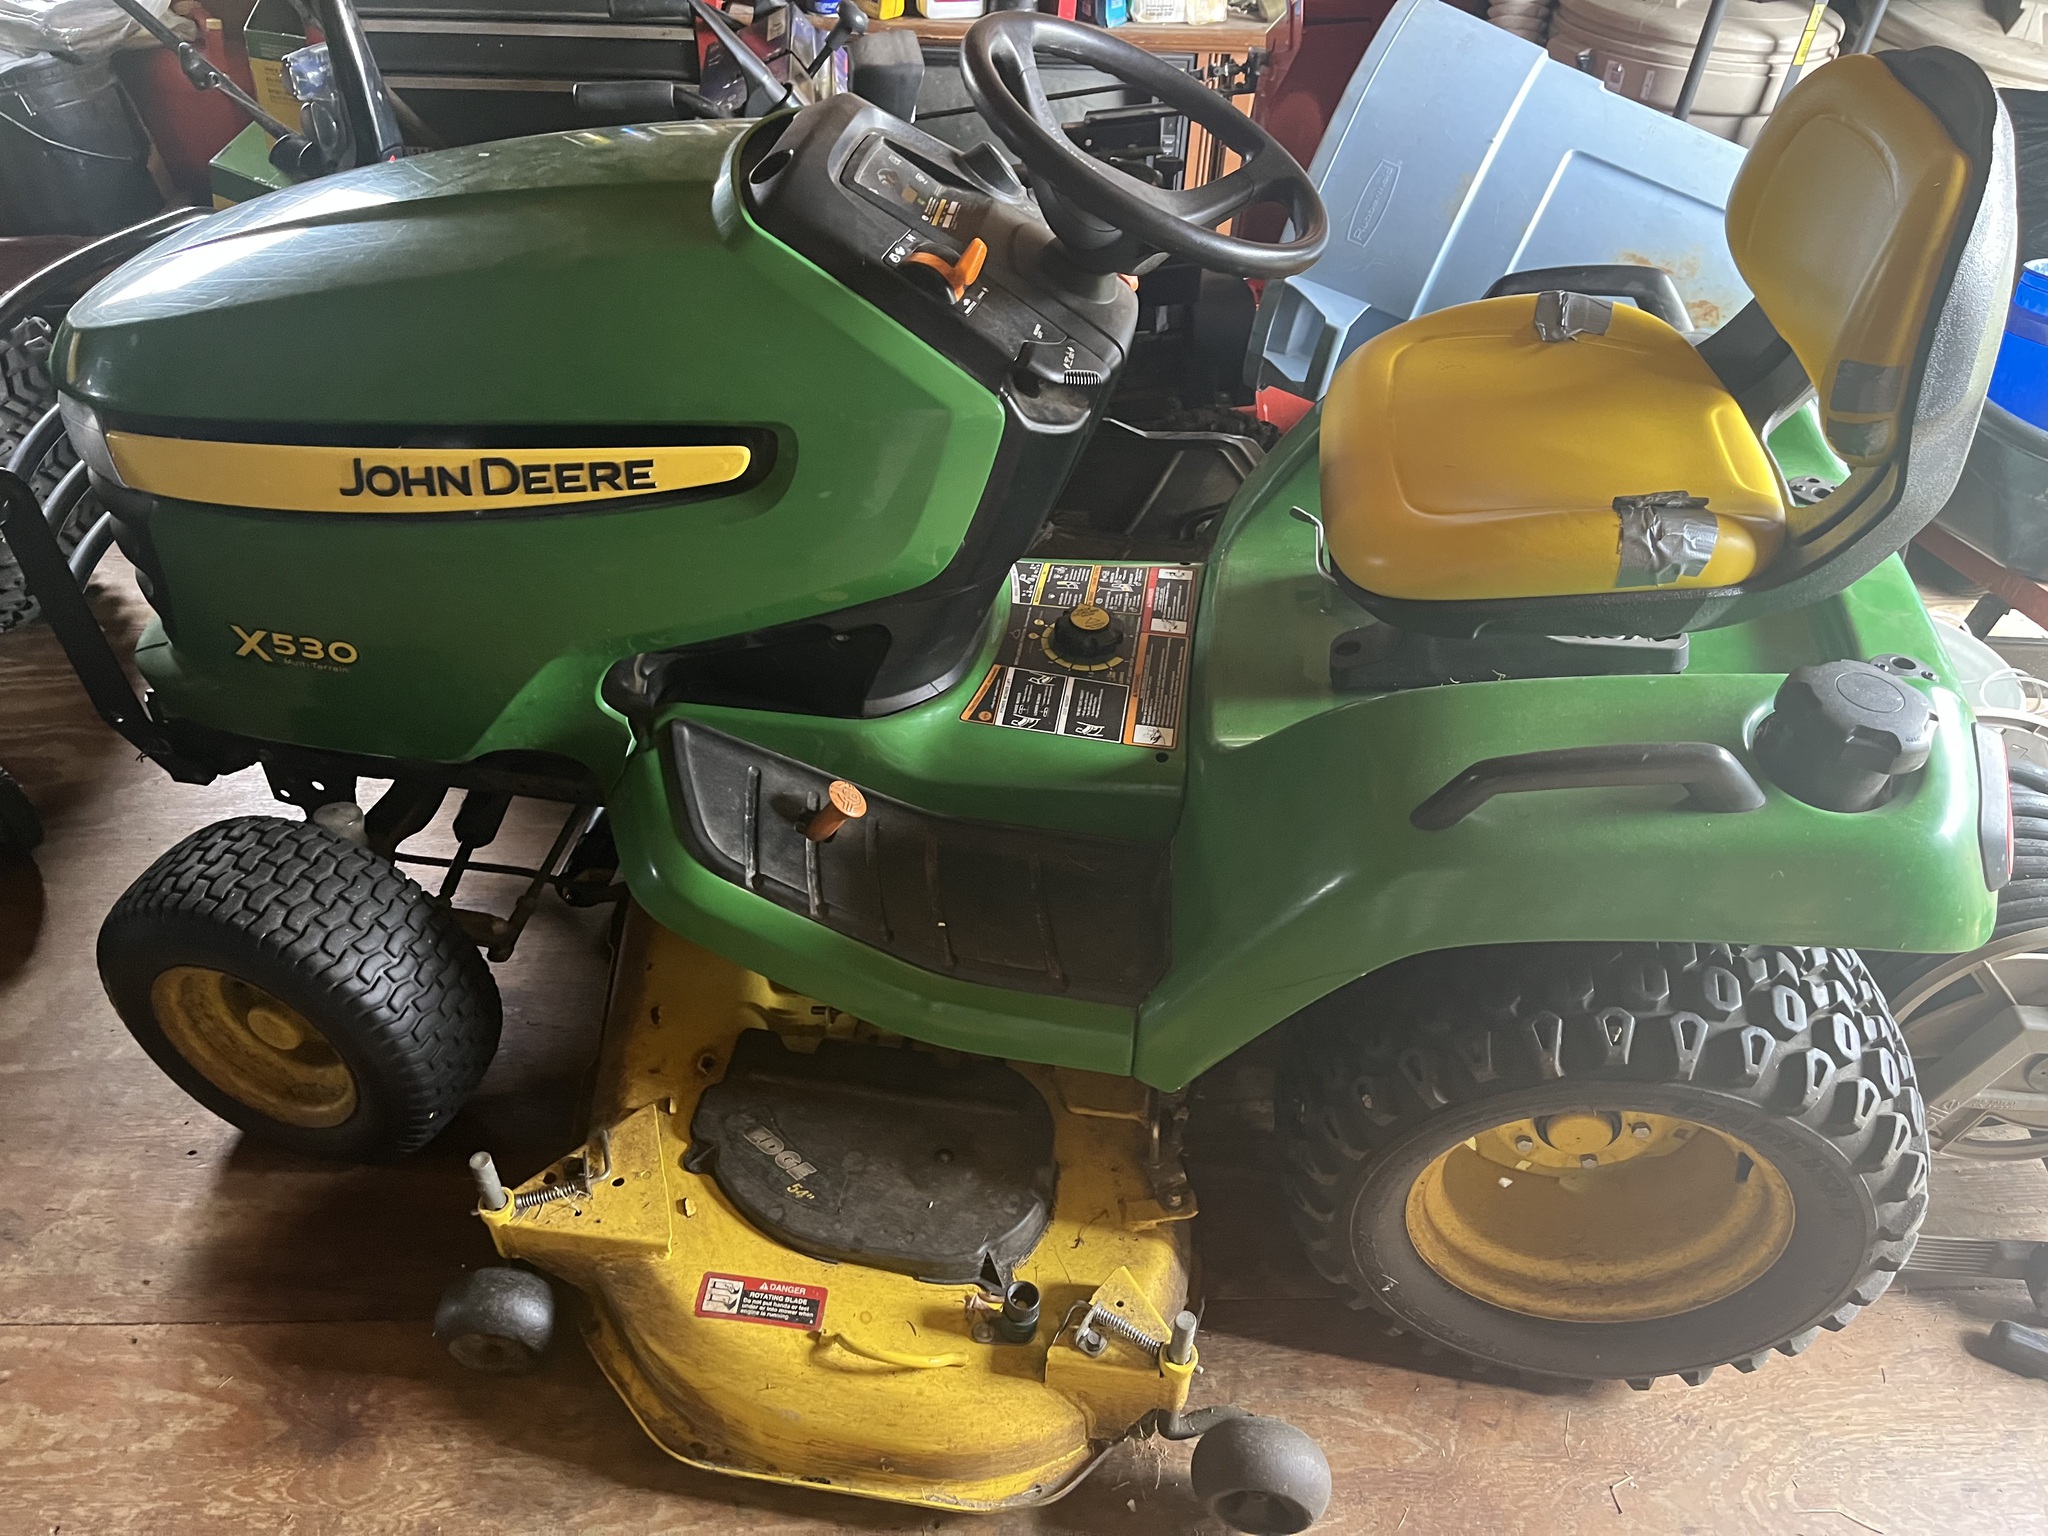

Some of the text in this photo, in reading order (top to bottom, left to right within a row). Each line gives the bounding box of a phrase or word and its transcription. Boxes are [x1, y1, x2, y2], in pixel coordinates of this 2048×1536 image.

[1351, 164, 1395, 241] Rubbermaid
[339, 458, 657, 498] JOHN DEERE
[230, 624, 358, 664] X530
[743, 1125, 817, 1180] EDGE
[749, 1292, 808, 1305] ROTATING BLADE
[770, 1283, 806, 1295] DANGER
[773, 1301, 790, 1309] hands
